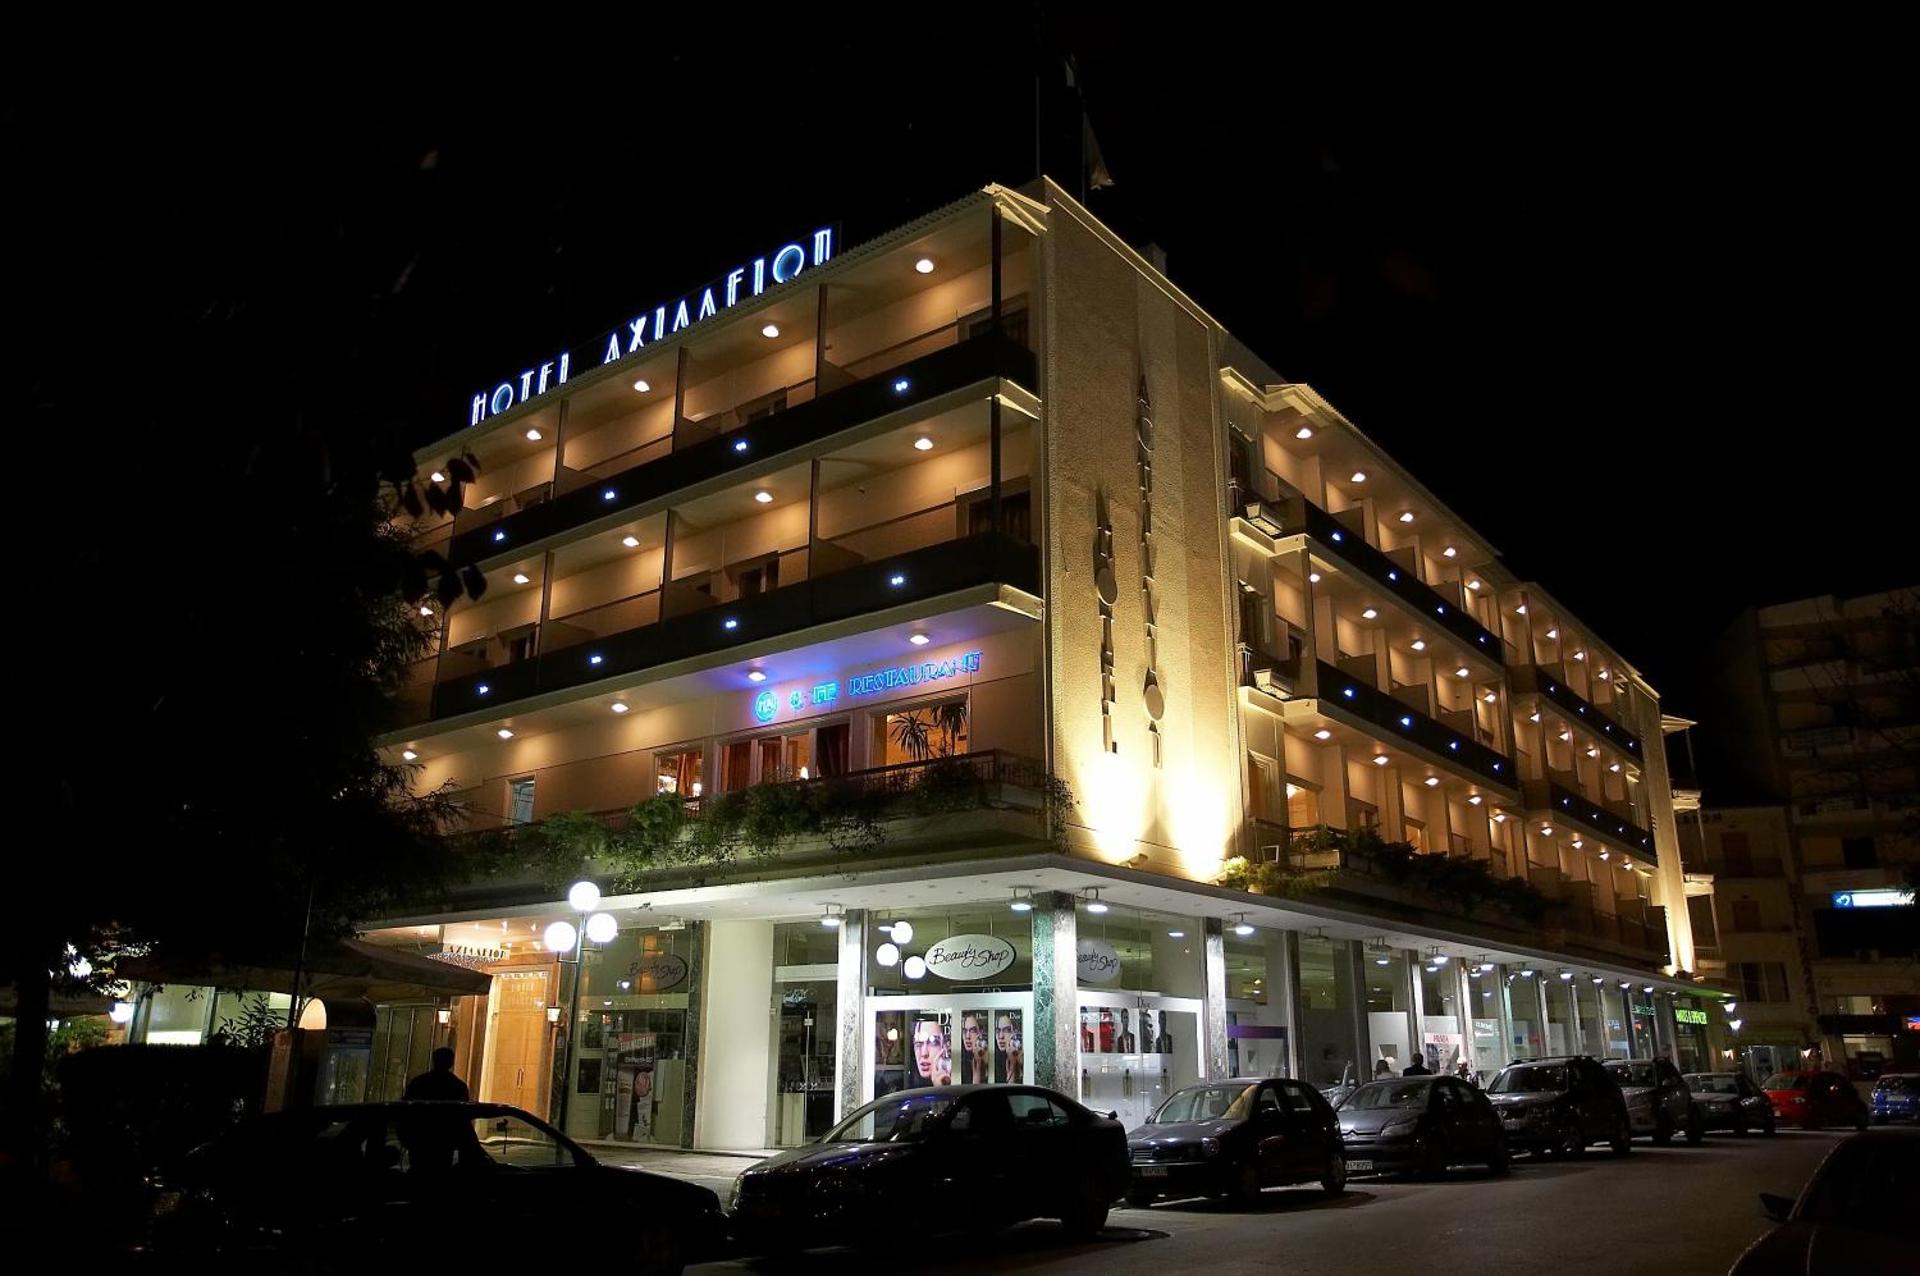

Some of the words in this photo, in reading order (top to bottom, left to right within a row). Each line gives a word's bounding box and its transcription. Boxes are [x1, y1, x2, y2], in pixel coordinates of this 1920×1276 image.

[931, 944, 977, 968] Beauty
[975, 948, 1010, 967] Shop
[1077, 949, 1099, 971] eauty
[1097, 955, 1118, 973] Shop
